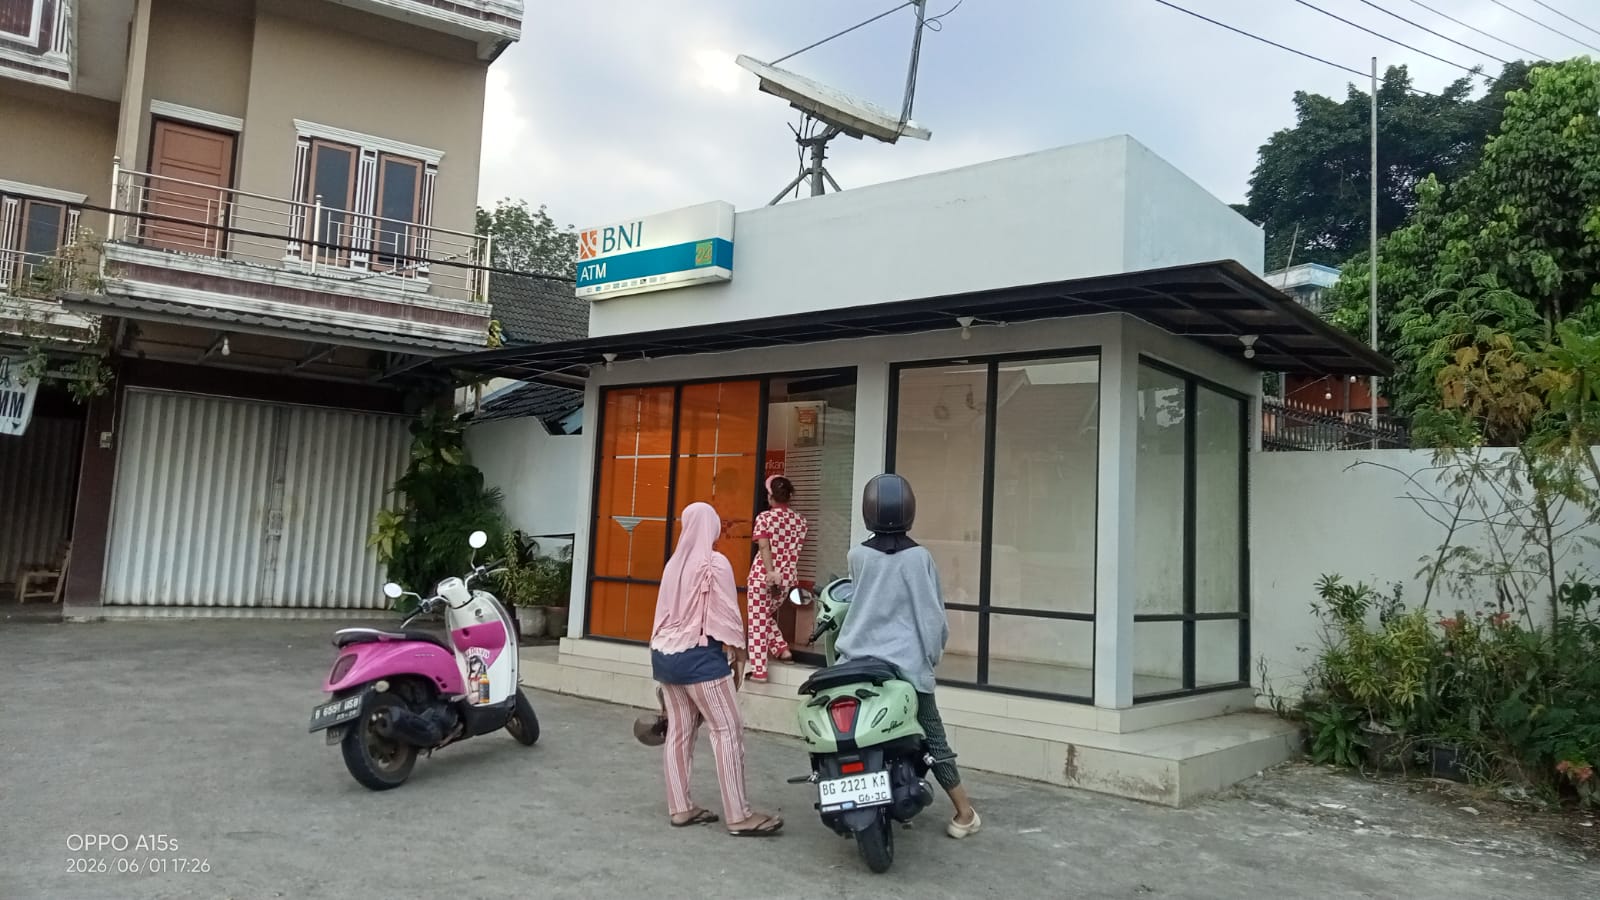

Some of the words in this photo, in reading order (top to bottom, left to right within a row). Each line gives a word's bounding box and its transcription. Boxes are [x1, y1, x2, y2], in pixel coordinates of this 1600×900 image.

[601, 221, 643, 253] BNI
[580, 262, 607, 282] ATM
[822, 782, 836, 796] BG
[841, 778, 867, 793] 2121
[872, 775, 886, 787] KA
